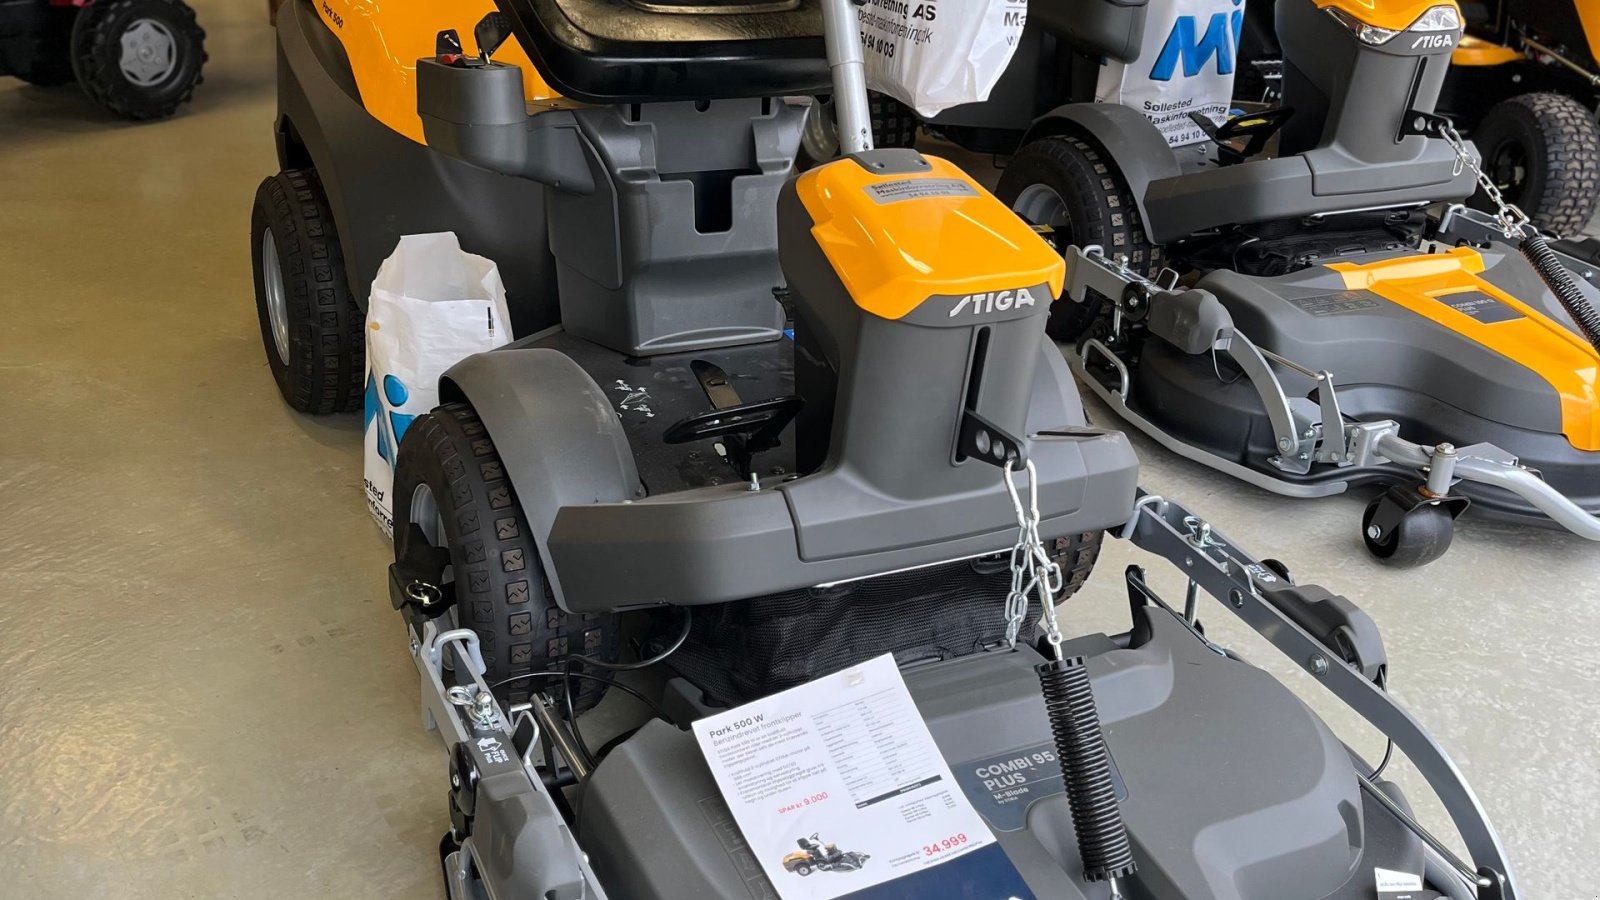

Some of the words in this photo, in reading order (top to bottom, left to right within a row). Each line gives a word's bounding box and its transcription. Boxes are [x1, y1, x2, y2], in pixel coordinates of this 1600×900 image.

[333, 12, 344, 29] 500
[912, 4, 936, 21] AS
[867, 35, 875, 50] 94
[876, 39, 884, 54] 10
[884, 41, 895, 57] 03
[1411, 34, 1453, 49] STIGA
[1143, 97, 1193, 113] Søllested
[1168, 136, 1179, 144] 54
[1181, 133, 1190, 141] 94
[1192, 131, 1200, 139] 10
[949, 288, 1035, 318] STIGA
[709, 724, 733, 739] Park
[733, 717, 753, 730] 500
[754, 713, 764, 722] W
[713, 726, 761, 747] Benzindrevet
[760, 711, 802, 730] frontklipper
[491, 750, 503, 763] FLIP
[975, 757, 1034, 778] COMBI
[1032, 750, 1056, 764] 95
[983, 772, 1026, 791] PLUS
[778, 804, 795, 813] SPAR
[803, 791, 828, 806] 9.000
[993, 787, 1029, 800] M-Blade
[923, 833, 968, 857] 34.999
